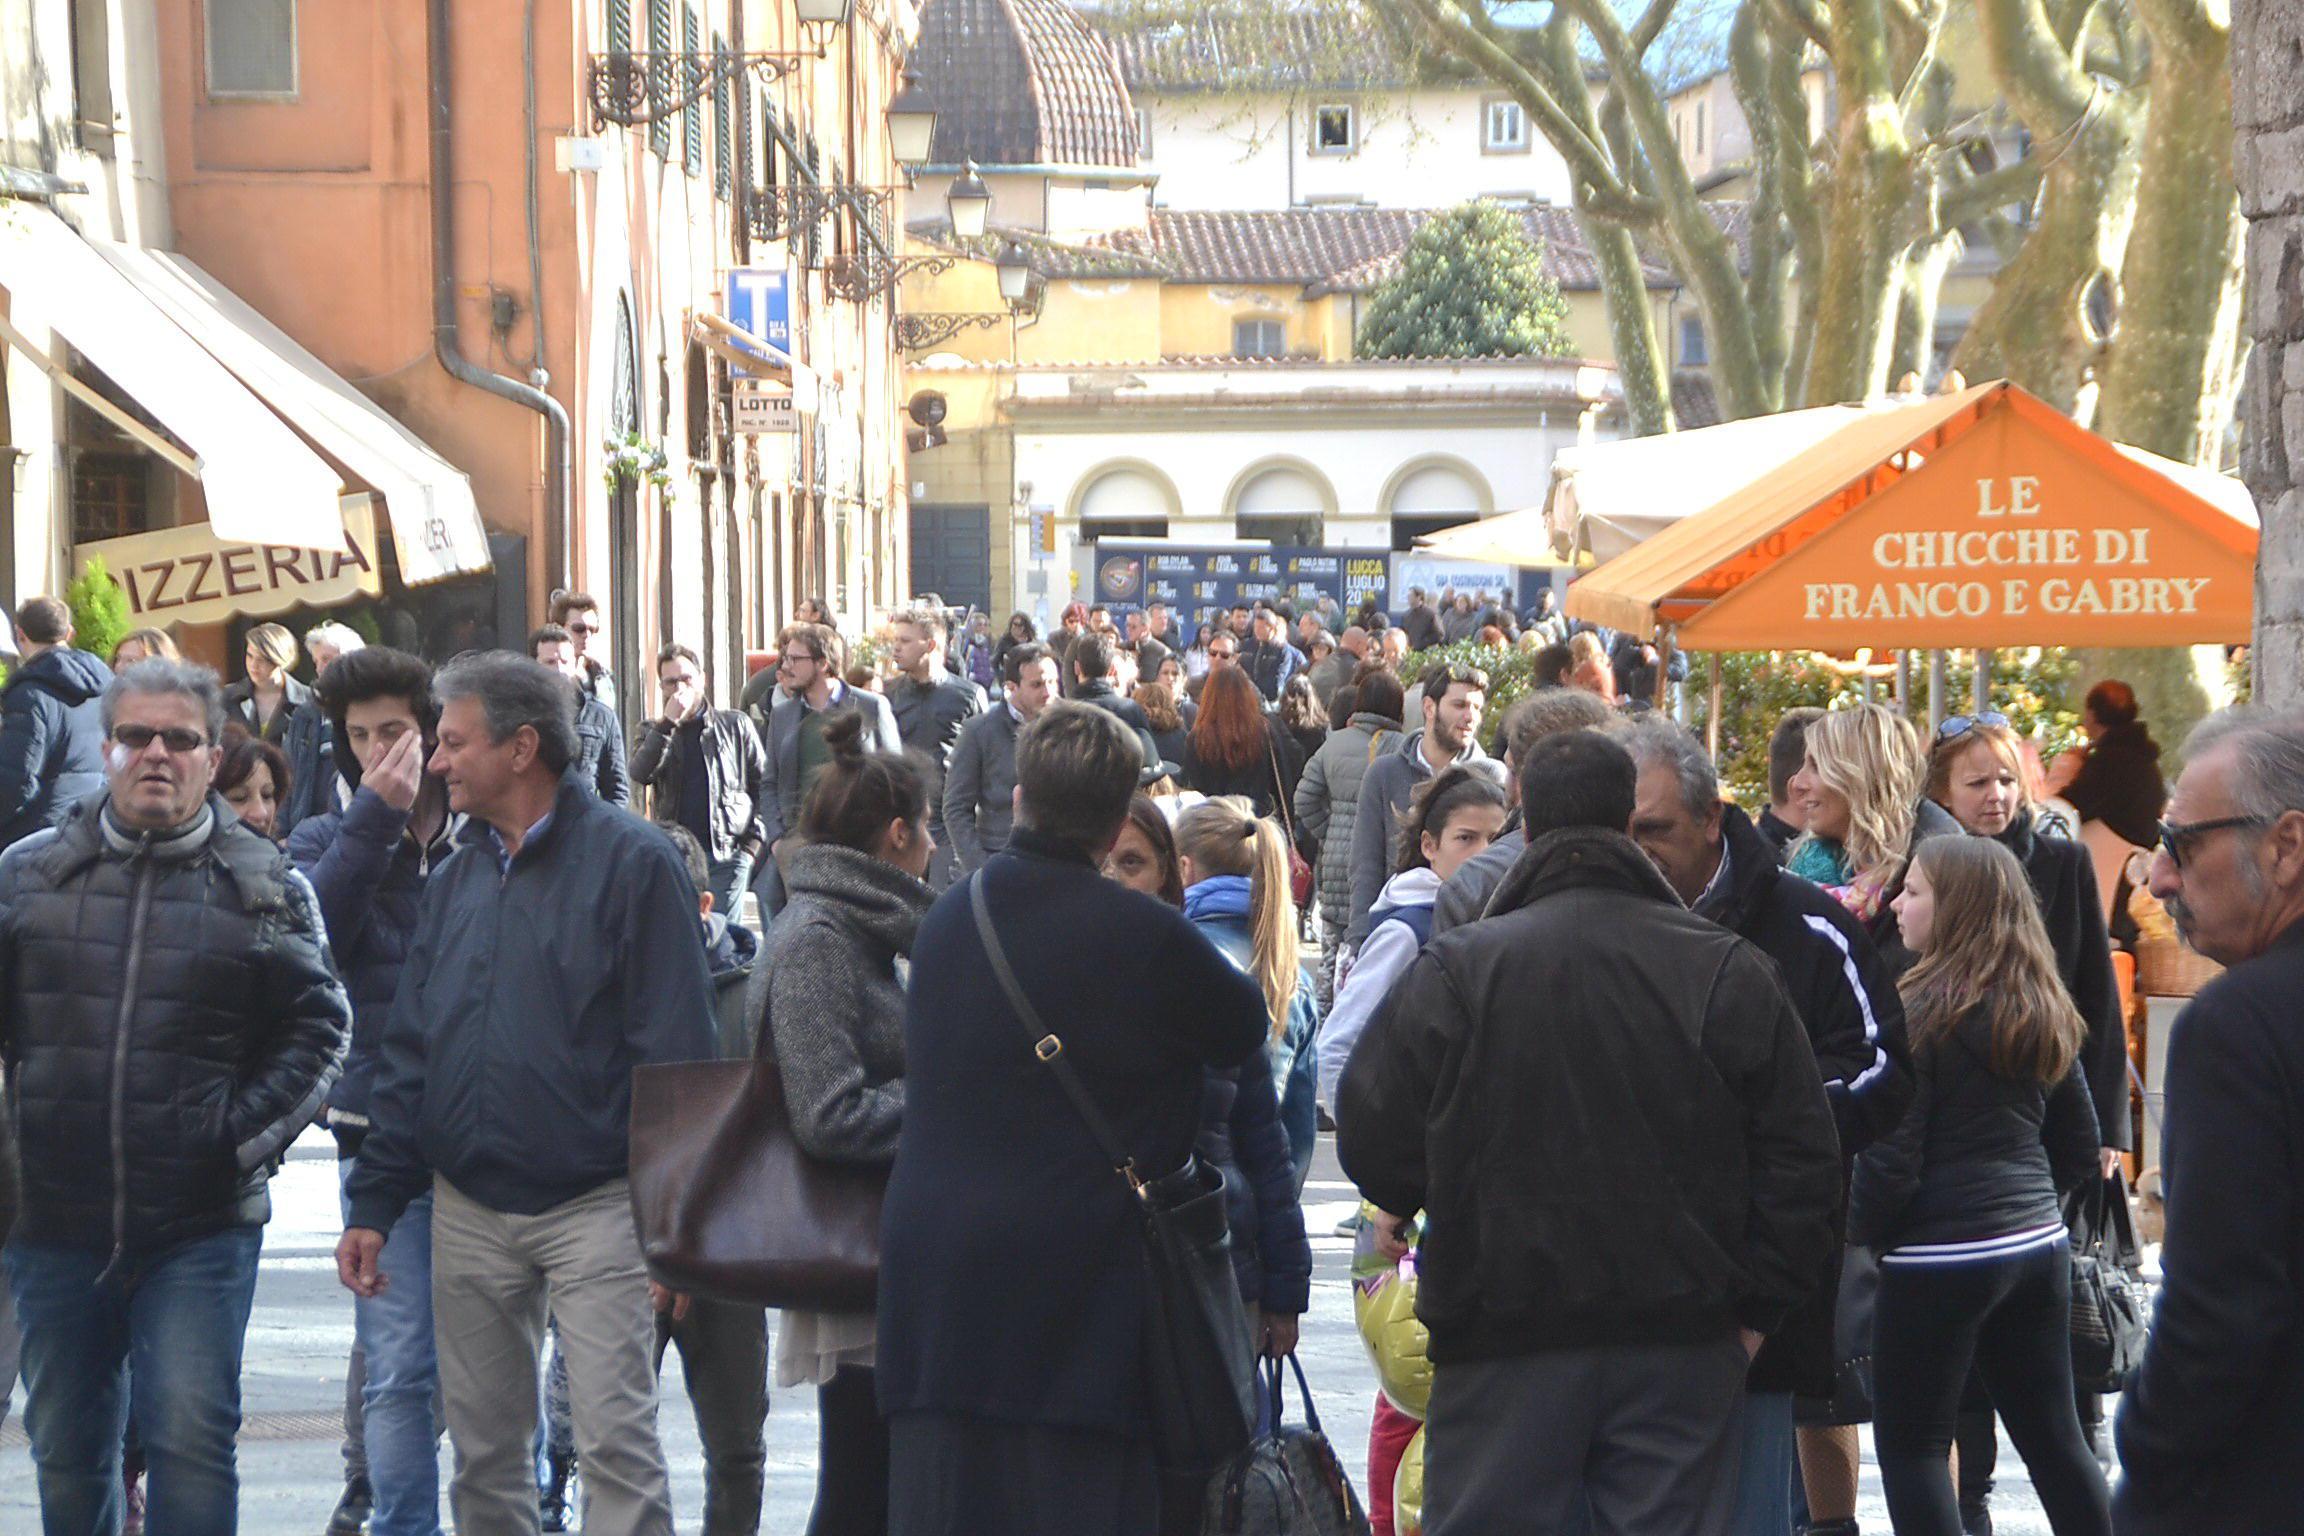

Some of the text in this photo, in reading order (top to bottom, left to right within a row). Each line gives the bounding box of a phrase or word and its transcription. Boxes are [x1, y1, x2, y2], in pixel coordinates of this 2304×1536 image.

[739, 398, 792, 411] LOTTO
[1976, 476, 2041, 517] LE
[1346, 559, 1384, 575] LUCCA
[1872, 528, 2150, 569] CHICCHE DI
[107, 529, 371, 614] IZZERIA
[1346, 574, 1386, 590] LUGLIO
[1803, 577, 2211, 619] FRANCO E GABRY
